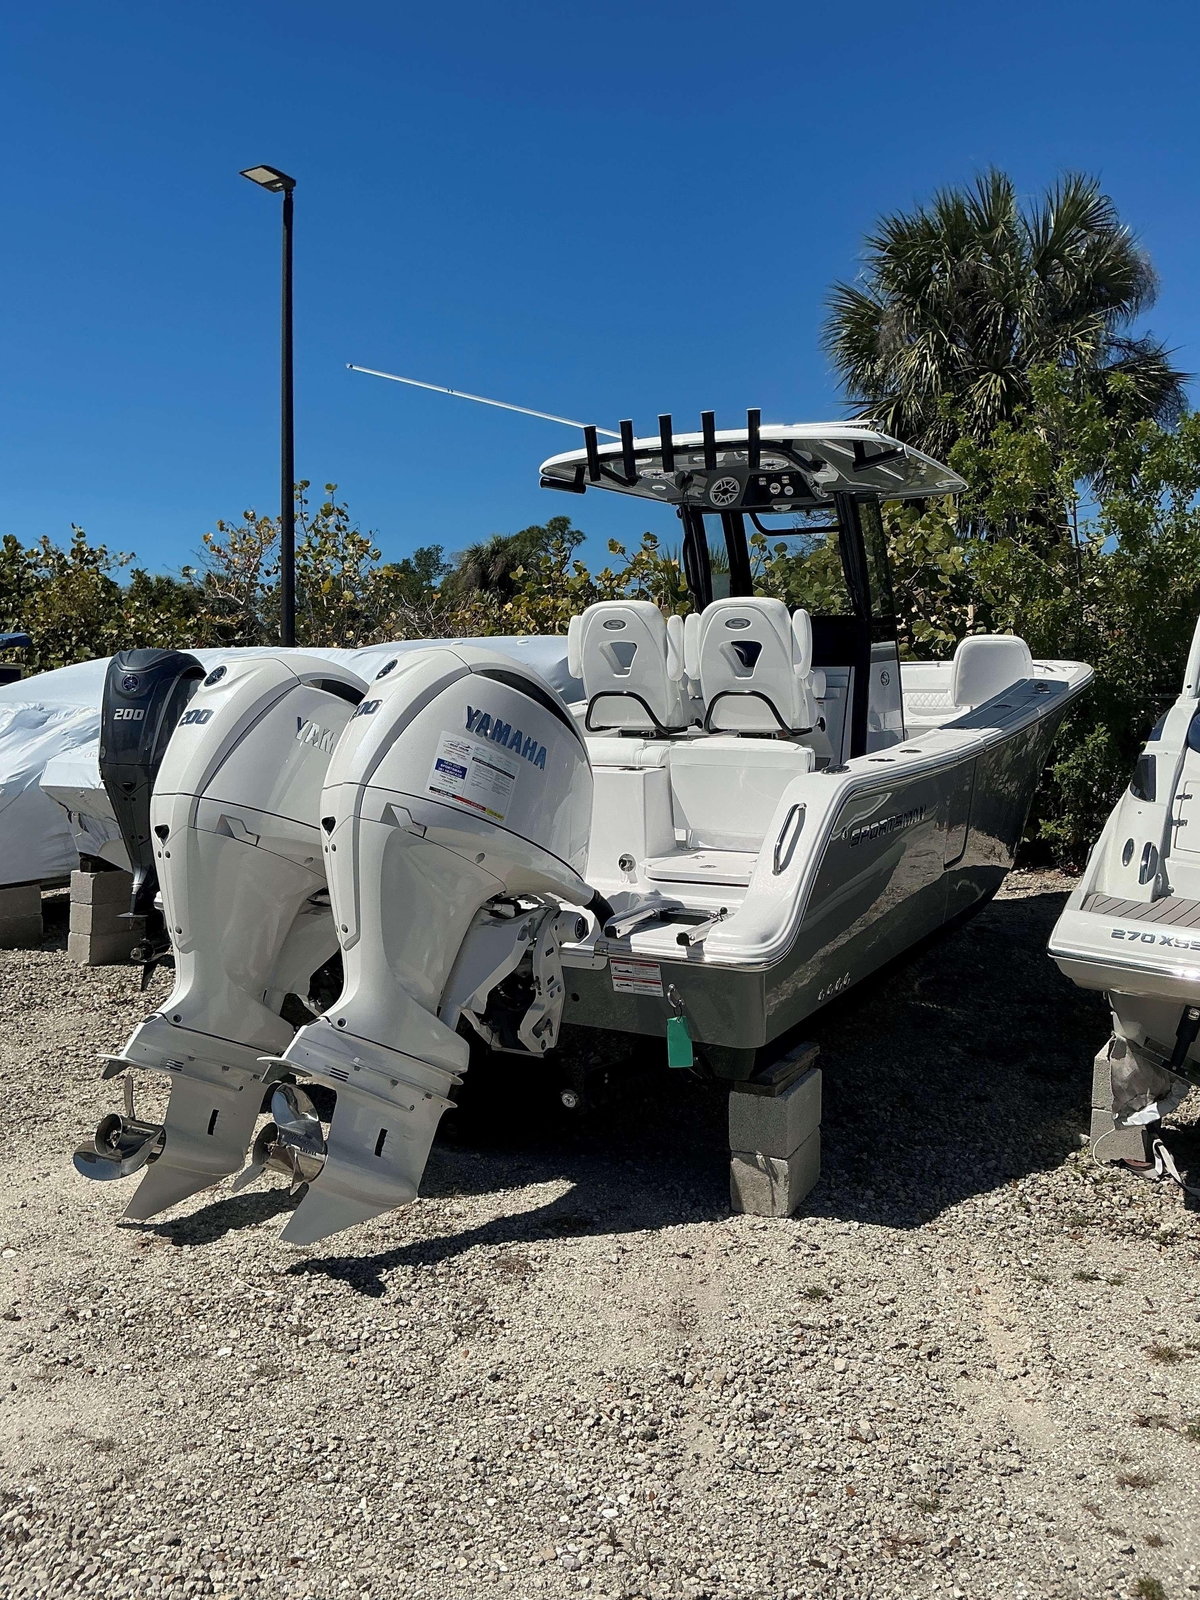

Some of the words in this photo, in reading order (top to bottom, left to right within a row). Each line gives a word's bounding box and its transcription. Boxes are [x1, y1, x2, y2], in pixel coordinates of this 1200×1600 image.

[113, 708, 145, 721] 200
[178, 709, 215, 727] 200
[465, 706, 547, 771] YAMAHA
[849, 804, 926, 848] SPORTSMAN
[1110, 928, 1156, 944] 270
